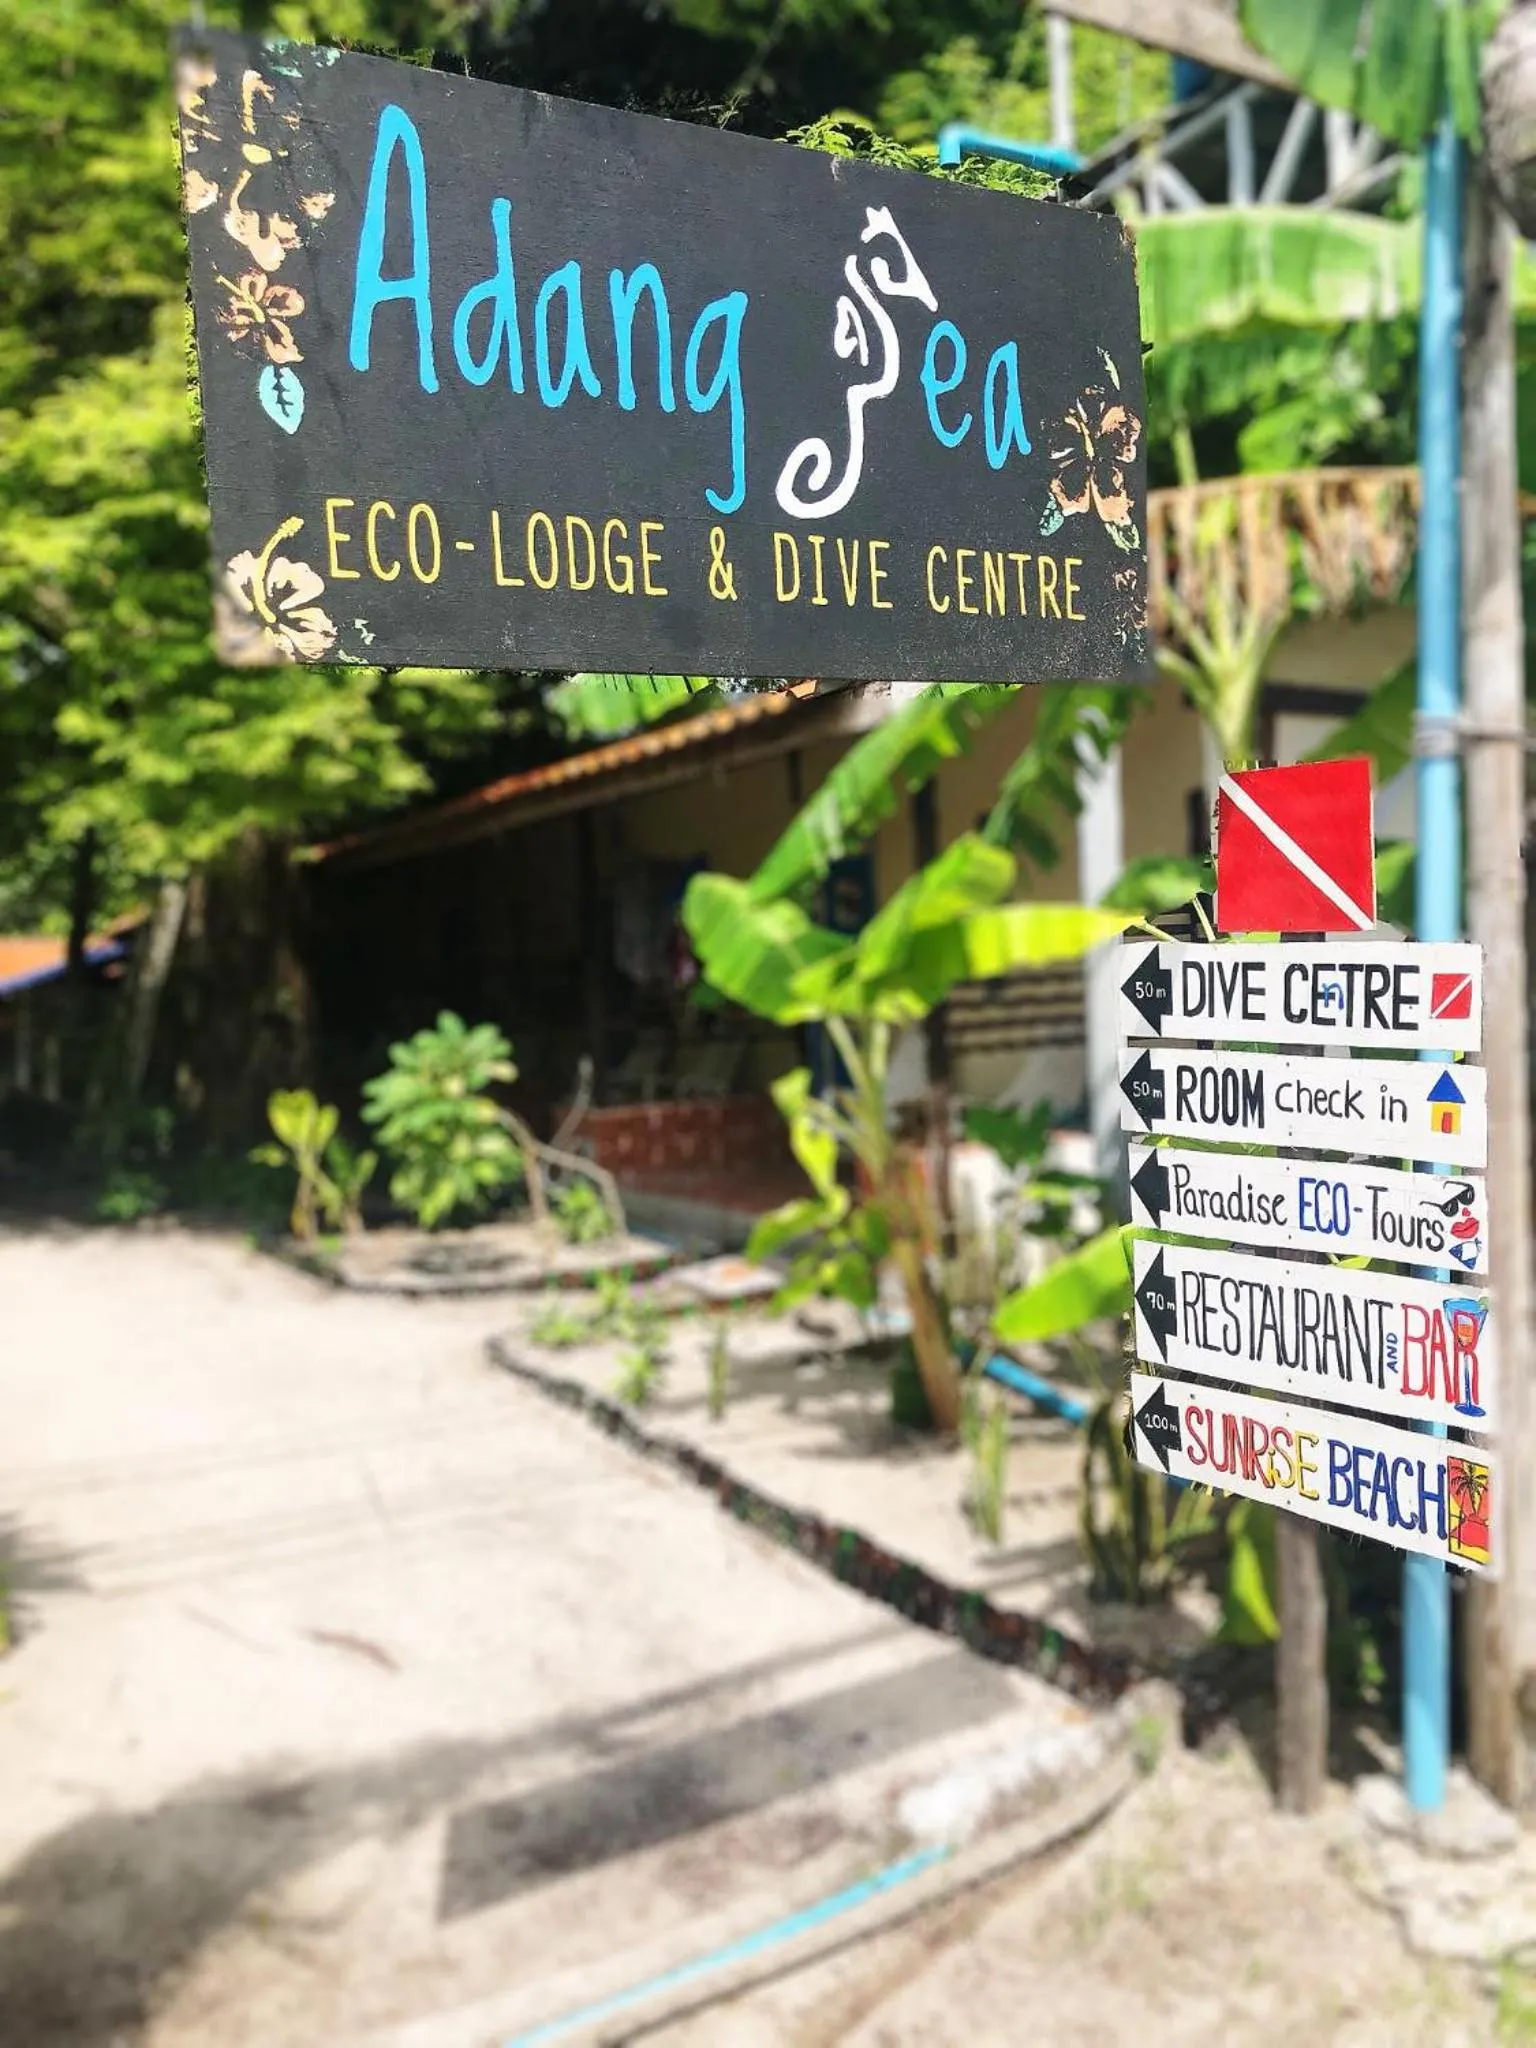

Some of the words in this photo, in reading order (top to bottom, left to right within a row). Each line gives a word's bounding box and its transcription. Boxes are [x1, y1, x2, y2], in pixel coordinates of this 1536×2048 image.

[349, 104, 748, 514] Adang
[325, 498, 669, 597] ECO-LODGE
[708, 526, 739, 602] &
[773, 531, 894, 609] DIVE
[926, 545, 1087, 622] CENTRE
[1182, 960, 1266, 1022] DIVE
[1175, 1064, 1265, 1129] ROOM
[1275, 1079, 1366, 1120] check
[1380, 1084, 1408, 1123] in
[1172, 1163, 1289, 1227] Paradise
[1299, 1176, 1446, 1252] ECO-Tours
[1181, 1270, 1394, 1389] RESTAURANT
[1385, 1331, 1399, 1374] AND
[1400, 1302, 1480, 1406] BAR
[1326, 1438, 1448, 1541] BEACH
